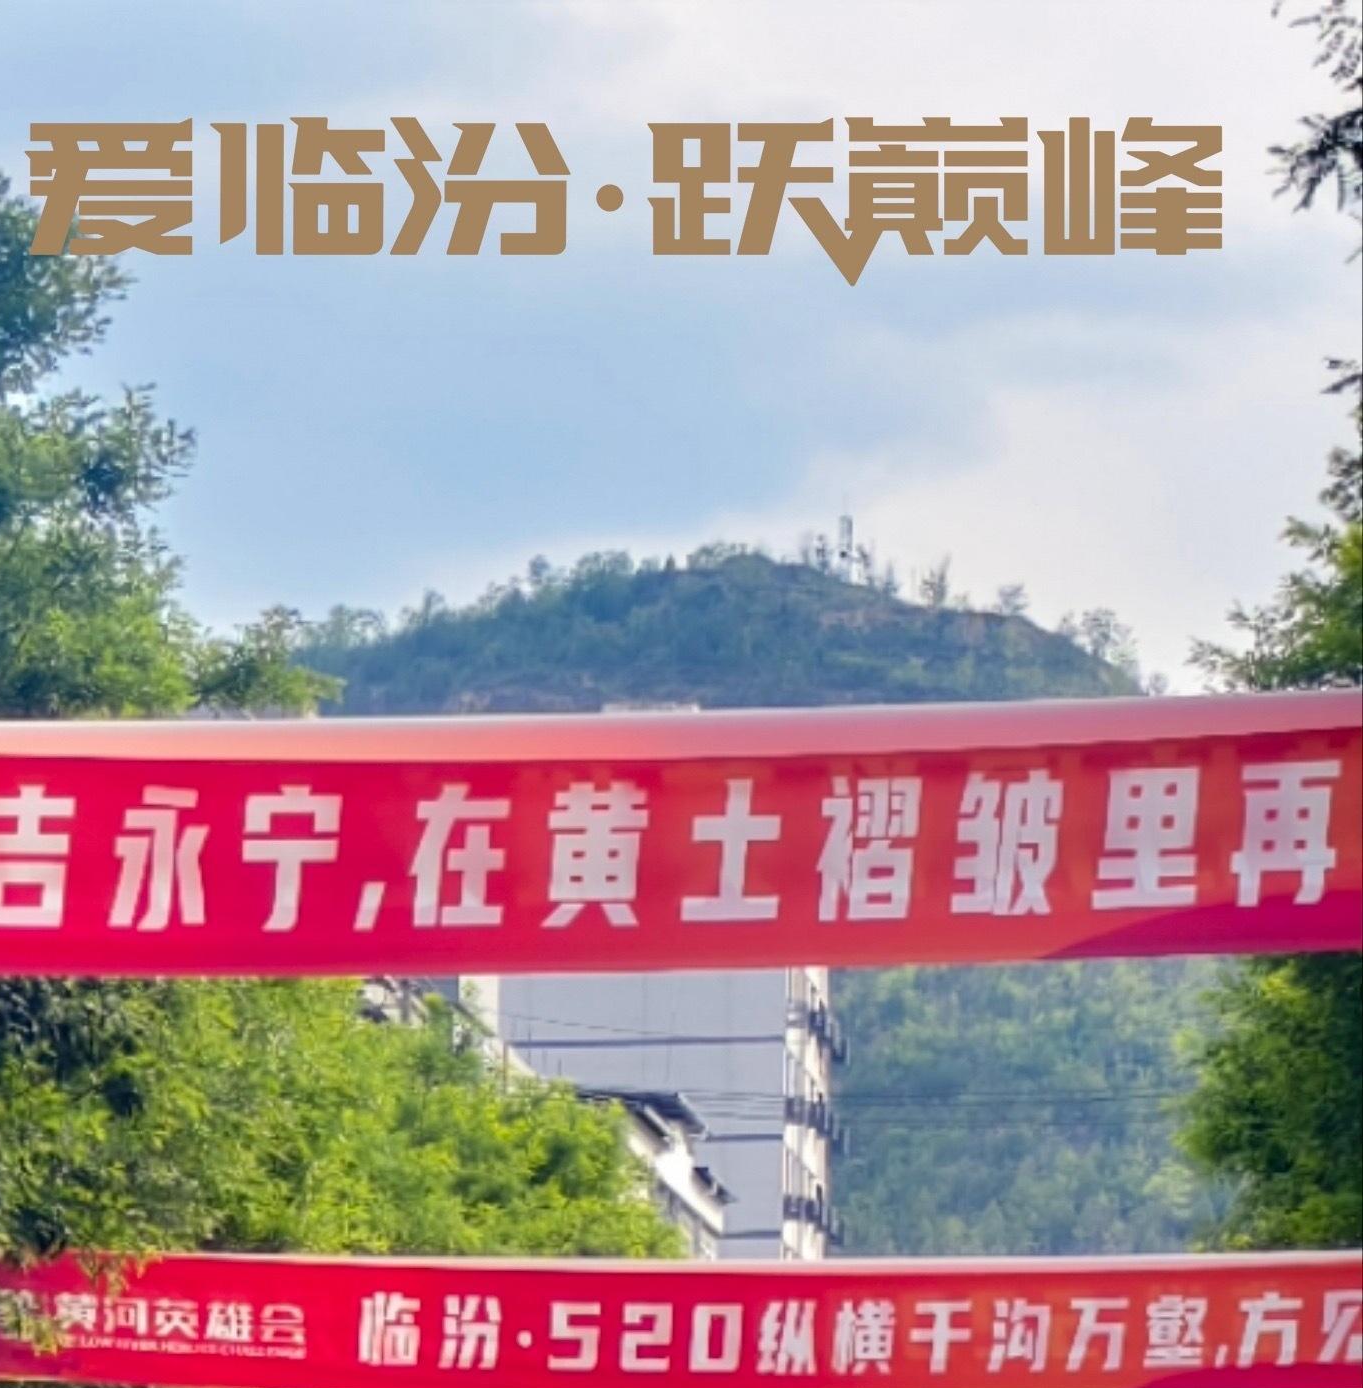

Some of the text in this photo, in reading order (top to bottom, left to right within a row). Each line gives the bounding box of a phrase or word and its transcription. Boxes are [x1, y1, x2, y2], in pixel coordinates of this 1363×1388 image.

[53, 1291, 307, 1346] 黄河英雄会
